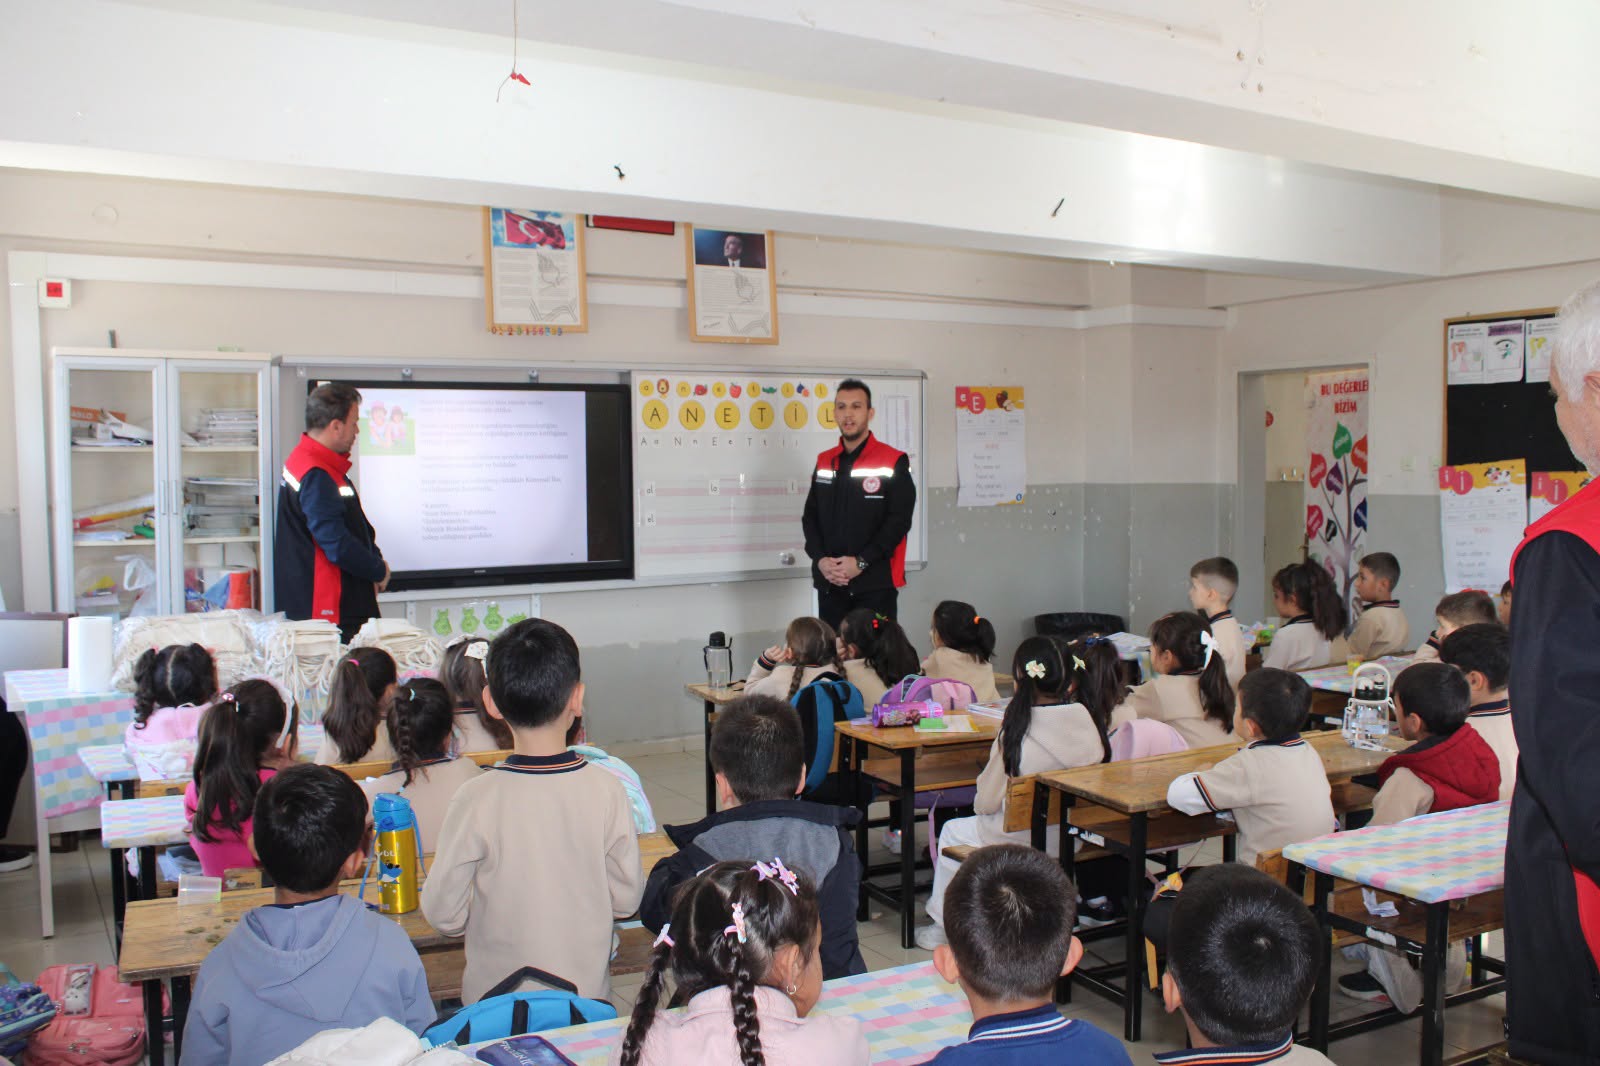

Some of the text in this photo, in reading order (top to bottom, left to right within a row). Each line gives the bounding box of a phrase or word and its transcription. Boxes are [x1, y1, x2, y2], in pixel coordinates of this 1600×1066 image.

[1333, 379, 1369, 394] DEĞERLE
[960, 393, 982, 412] e E
[649, 407, 662, 423] A
[686, 407, 698, 424] N
[723, 407, 732, 423] E
[757, 407, 767, 423] T
[825, 407, 834, 423] L
